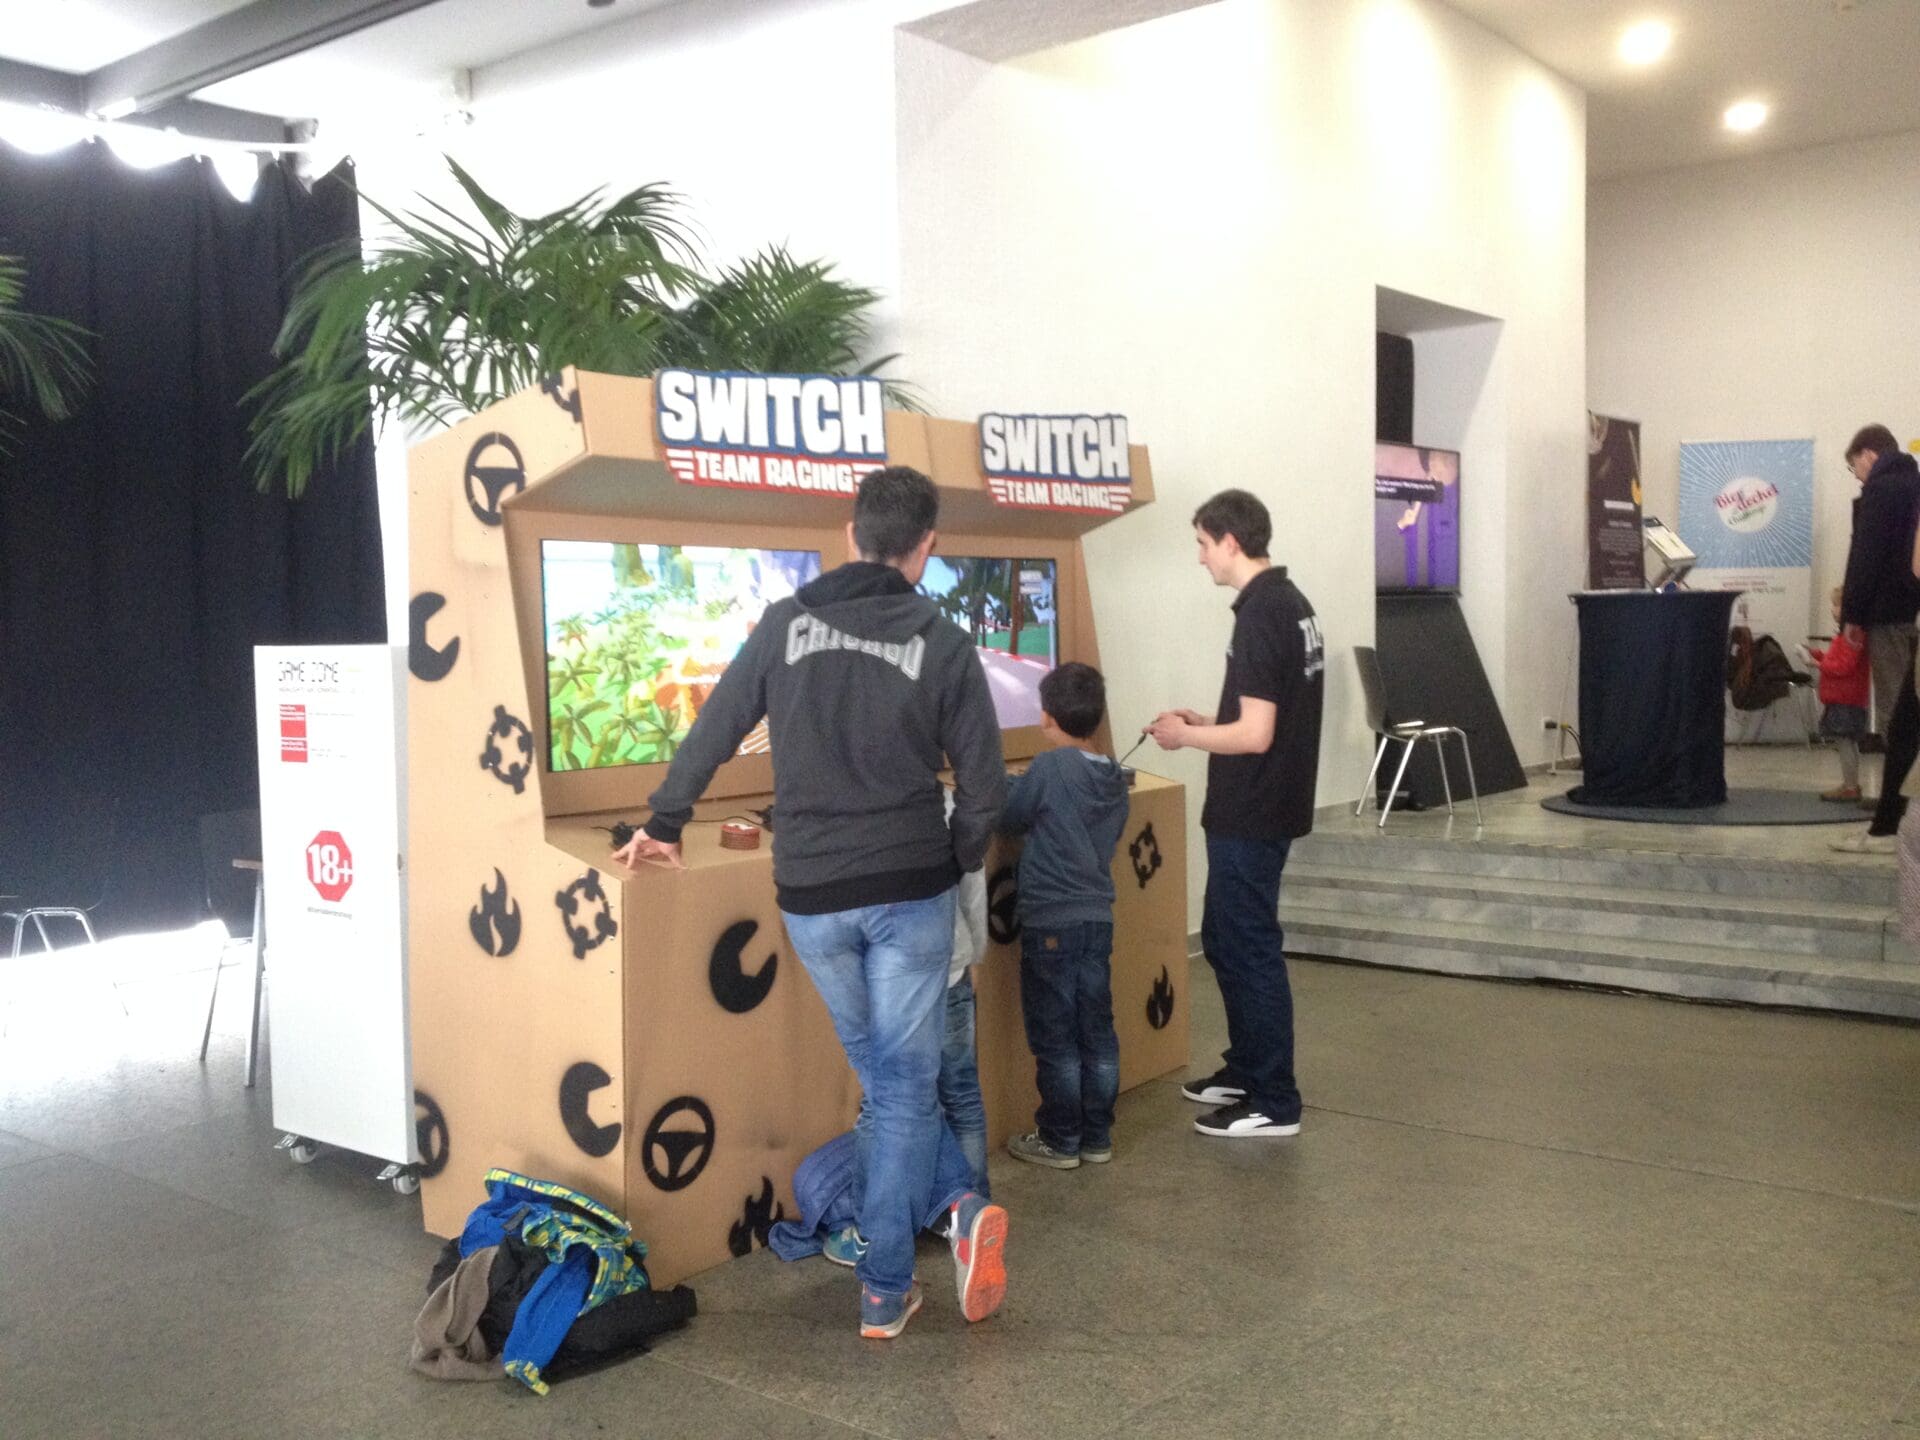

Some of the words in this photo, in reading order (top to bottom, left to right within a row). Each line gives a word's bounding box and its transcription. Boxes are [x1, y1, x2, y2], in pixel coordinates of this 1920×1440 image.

[659, 371, 884, 456] SWITCH
[982, 415, 1130, 480] SWITCH
[694, 451, 761, 485] TEAM
[764, 456, 854, 493] RACING
[1006, 479, 1050, 506] TEAM
[1052, 482, 1111, 509] RACING
[307, 843, 353, 886] 18+
